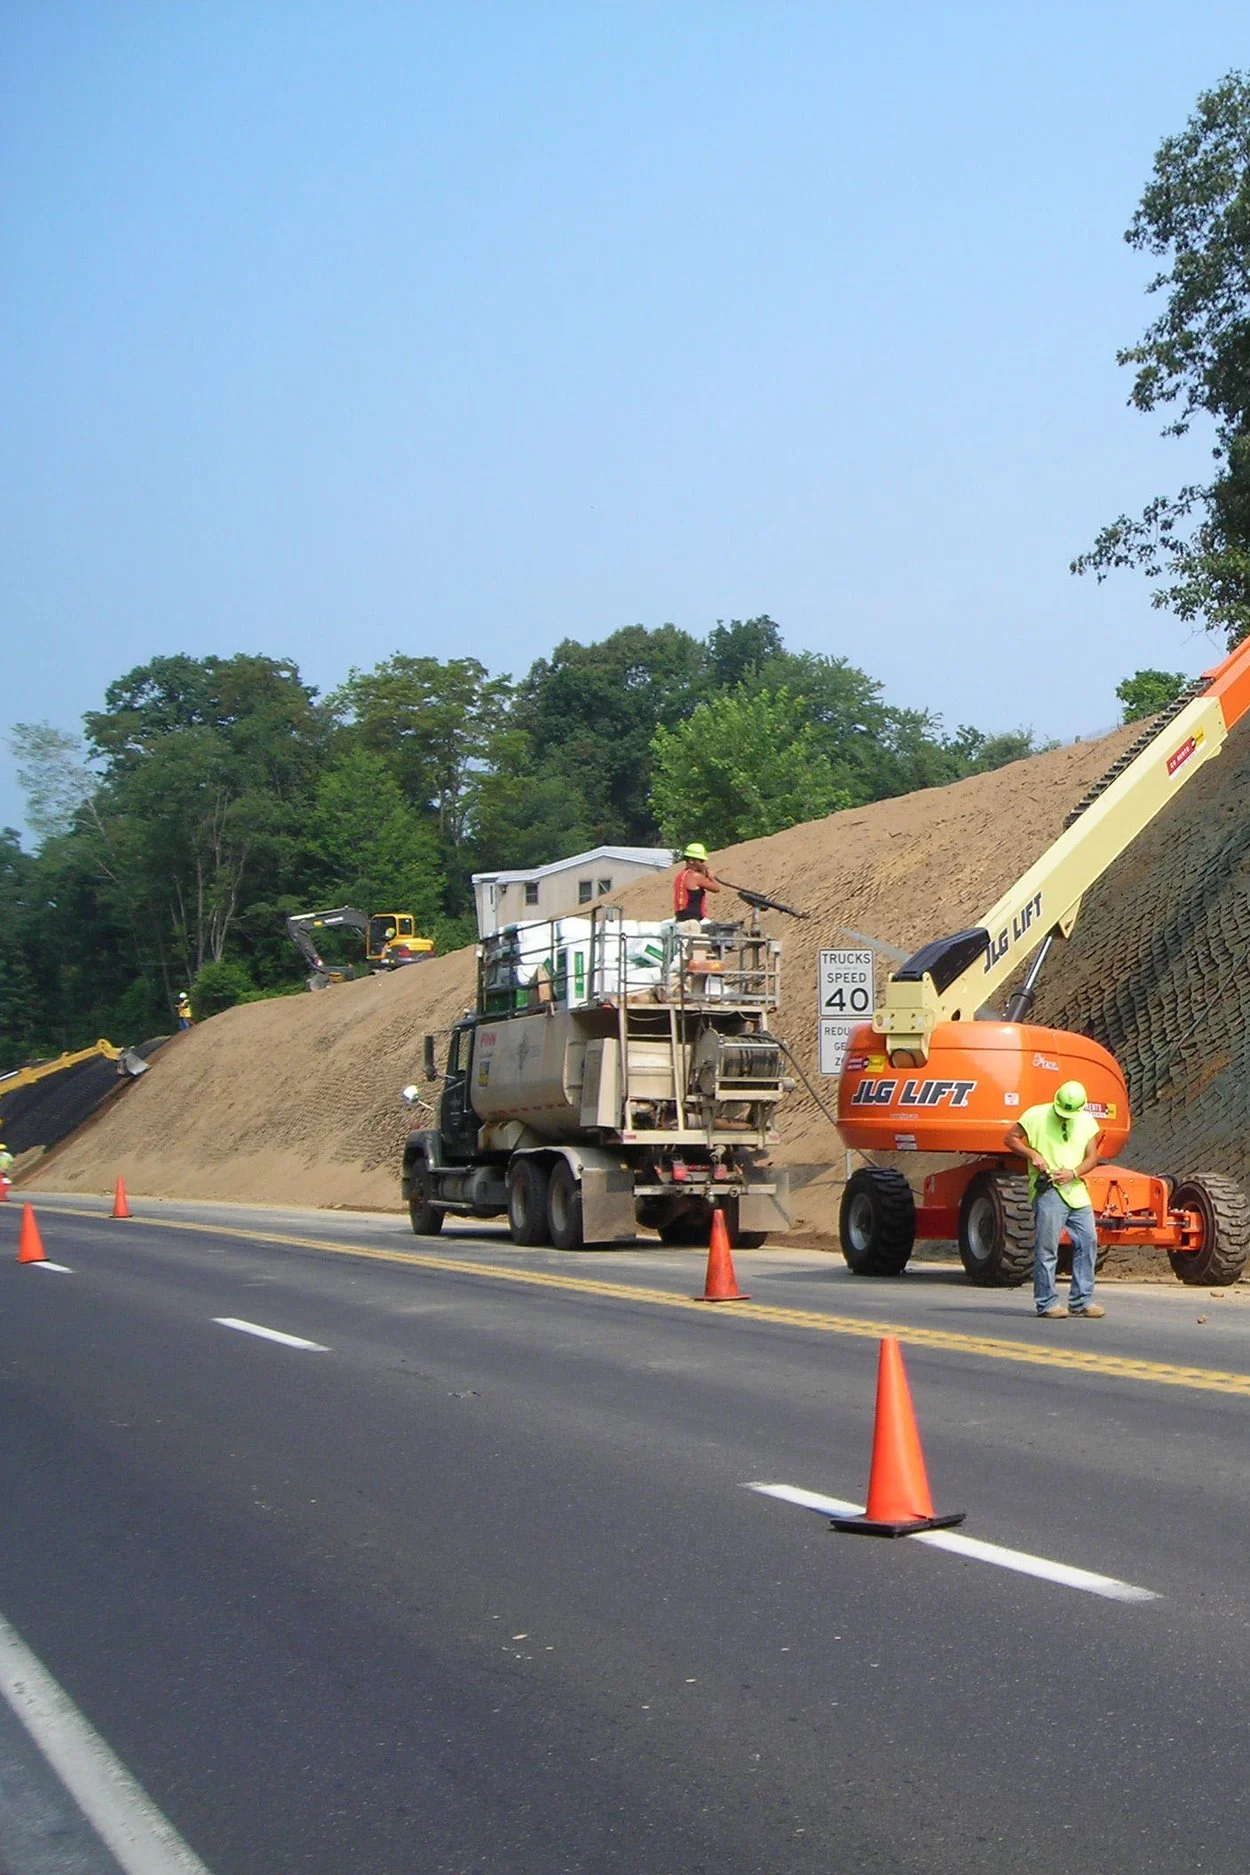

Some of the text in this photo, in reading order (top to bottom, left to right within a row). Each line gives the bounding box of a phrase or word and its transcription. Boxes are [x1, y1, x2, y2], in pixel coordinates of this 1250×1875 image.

[983, 890, 1042, 975] JLG LIFT
[822, 953, 871, 964] TRUCKS
[827, 972, 867, 983] SPEED
[825, 987, 869, 1012] 40
[824, 1026, 851, 1036] REDU
[834, 1042, 846, 1051] GE
[850, 1079, 898, 1105] JLG
[898, 1079, 977, 1107] LIFT
